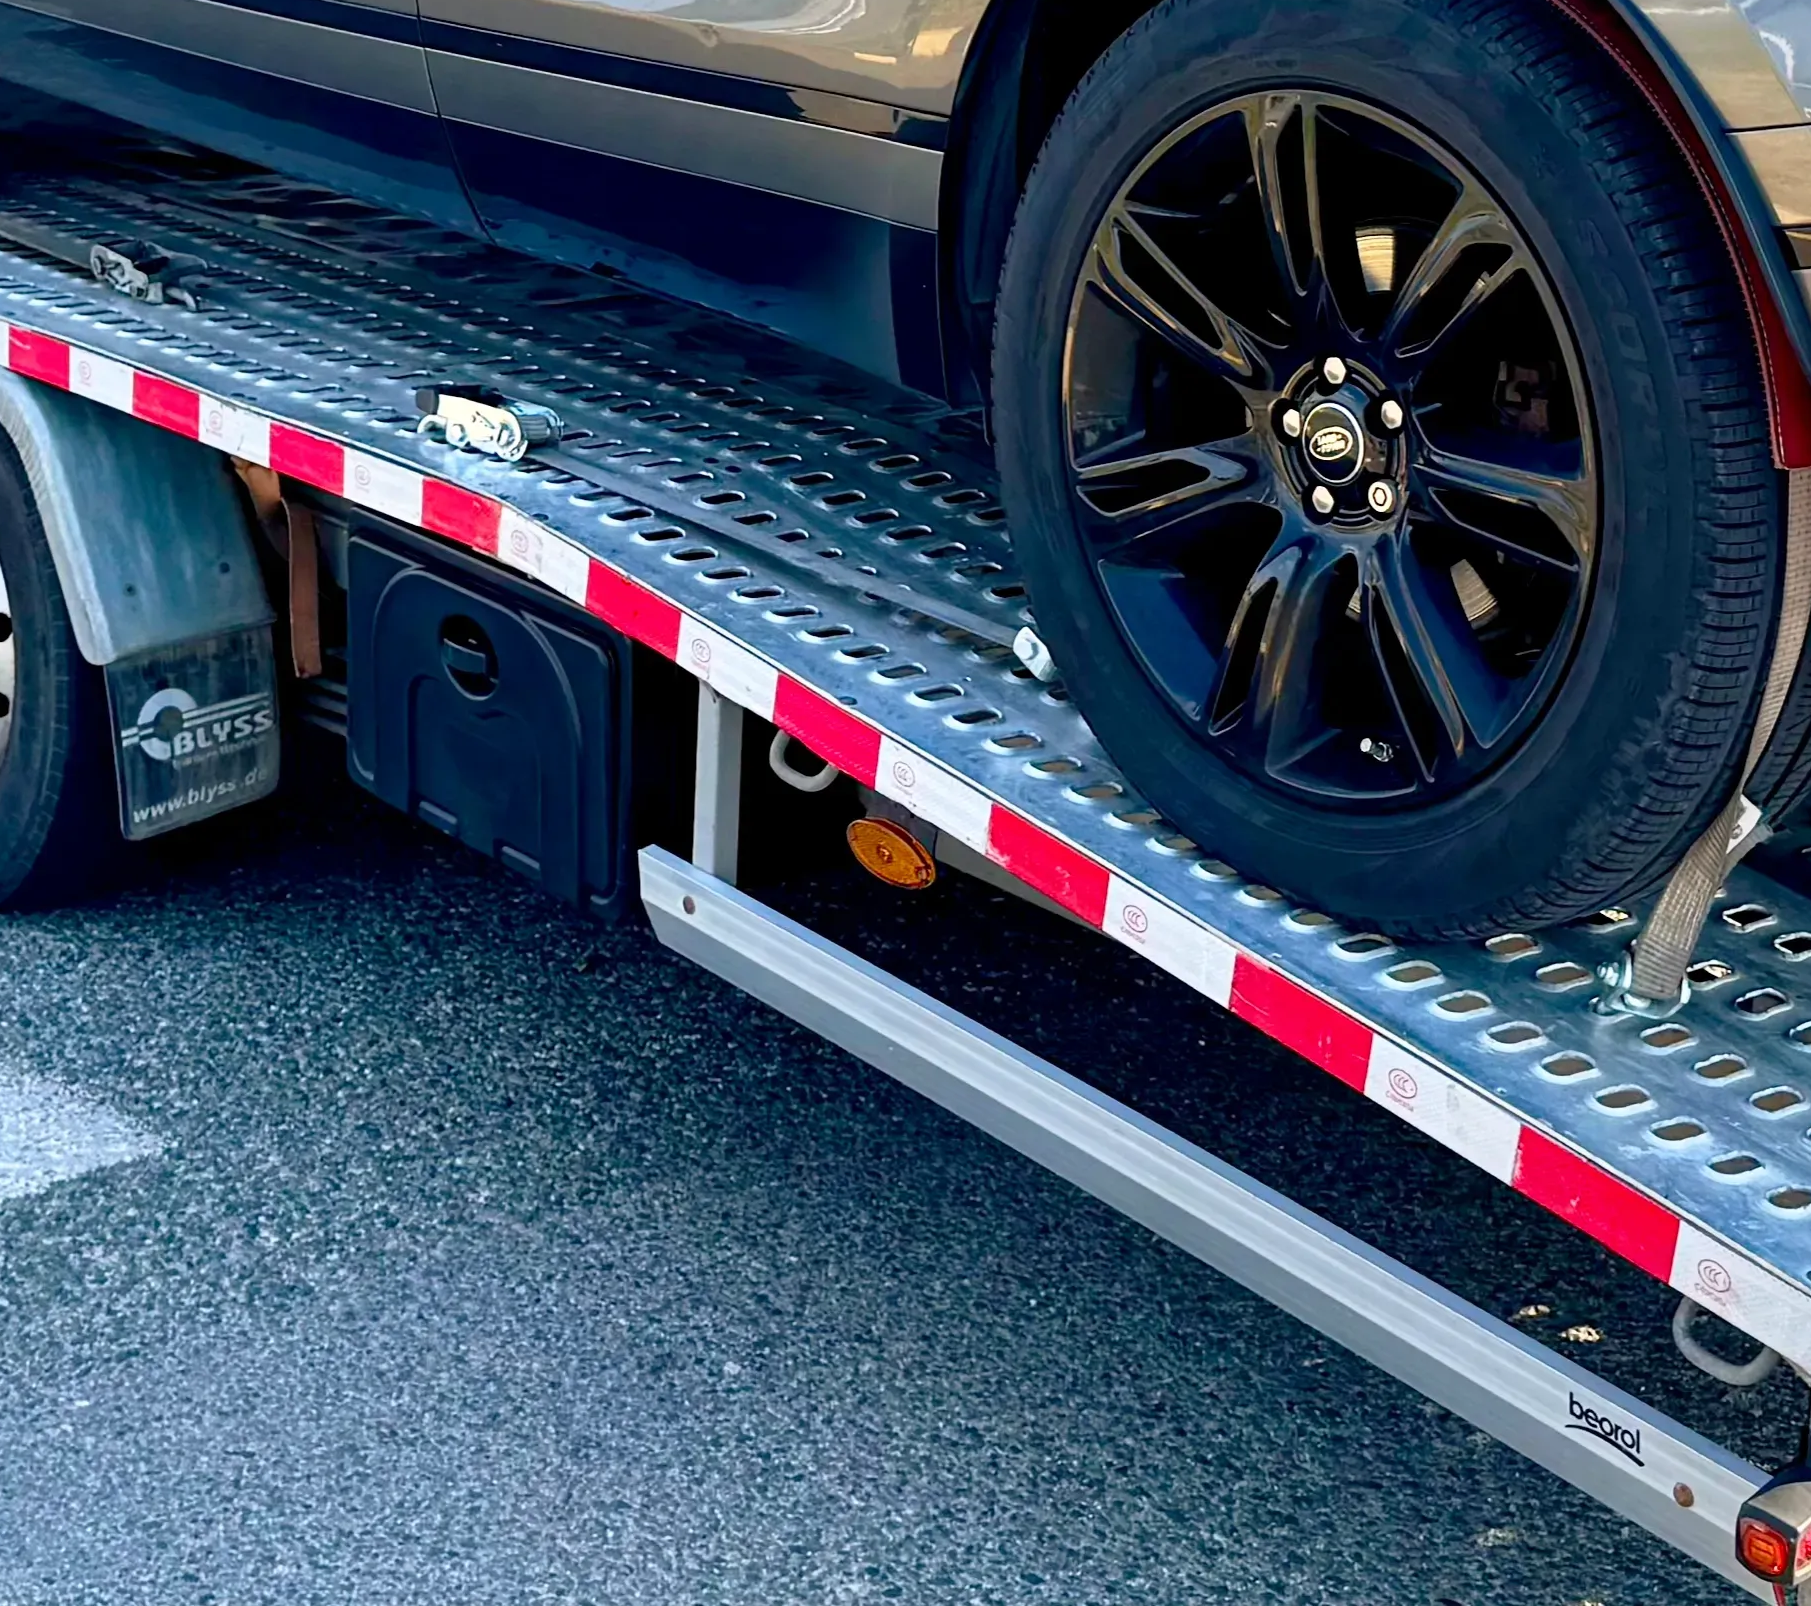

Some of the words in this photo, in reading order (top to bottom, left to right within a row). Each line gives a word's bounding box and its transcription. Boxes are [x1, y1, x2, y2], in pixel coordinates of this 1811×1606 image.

[172, 709, 274, 756] BLYSS
[133, 767, 268, 823] www.blyss.de
[1569, 1391, 1640, 1454] beorol
